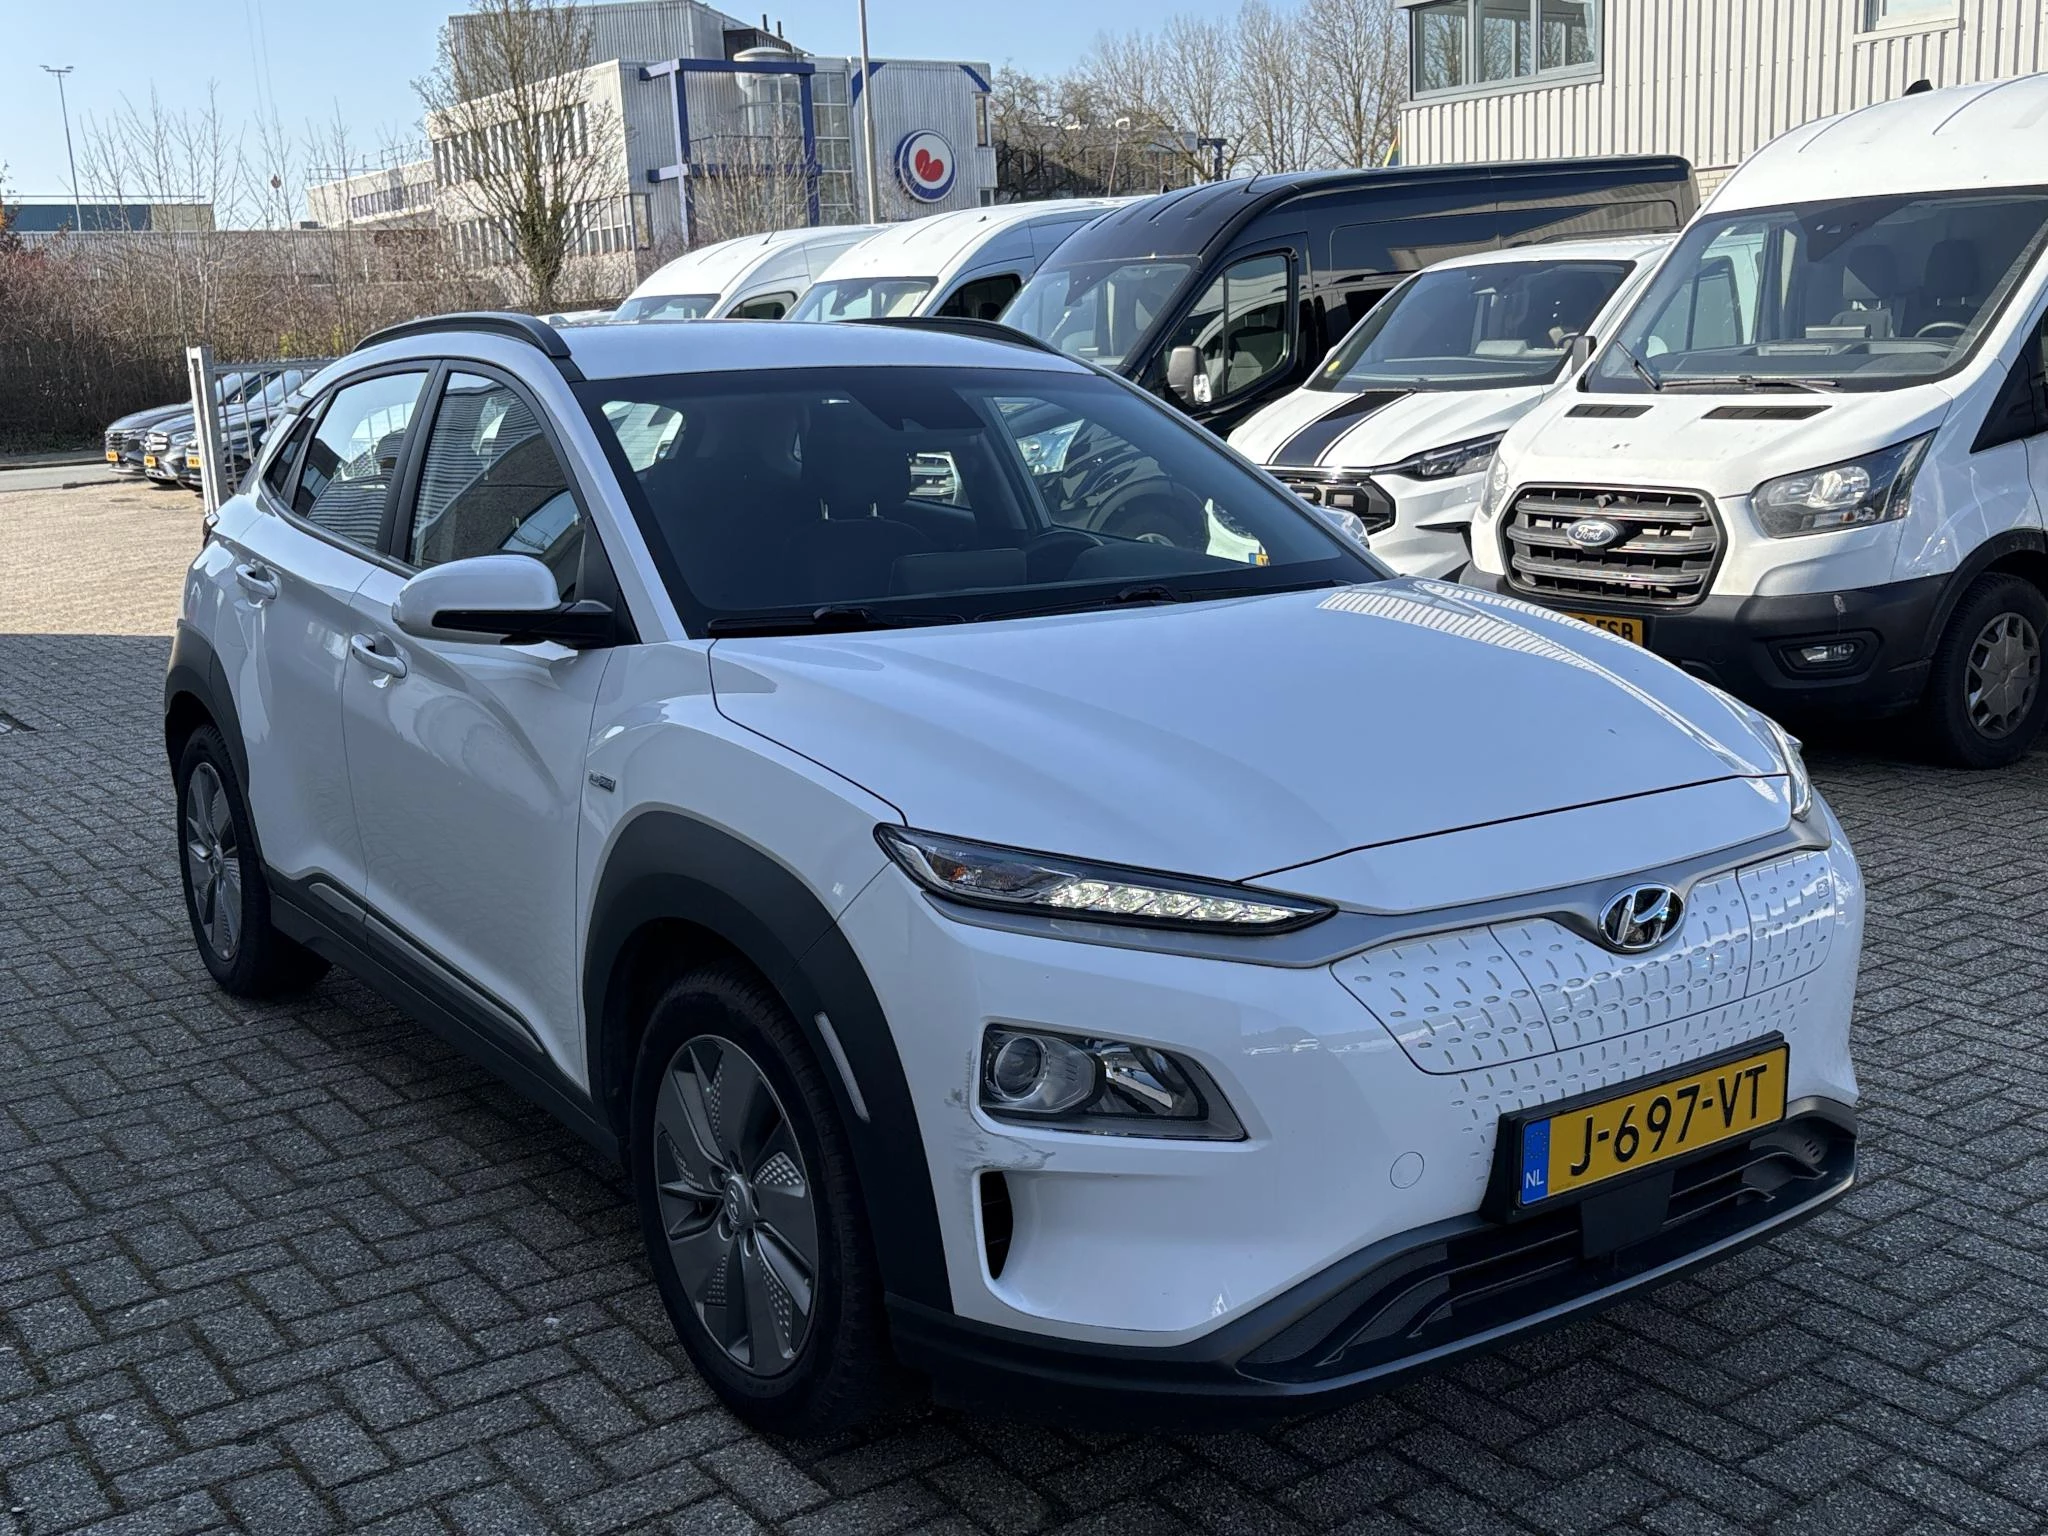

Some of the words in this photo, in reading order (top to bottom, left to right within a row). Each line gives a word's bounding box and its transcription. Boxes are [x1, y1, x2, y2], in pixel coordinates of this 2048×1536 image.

[1575, 524, 1604, 540] Ford
[1570, 1063, 1768, 1176] J-697-VT
[1525, 1169, 1545, 1189] NL
